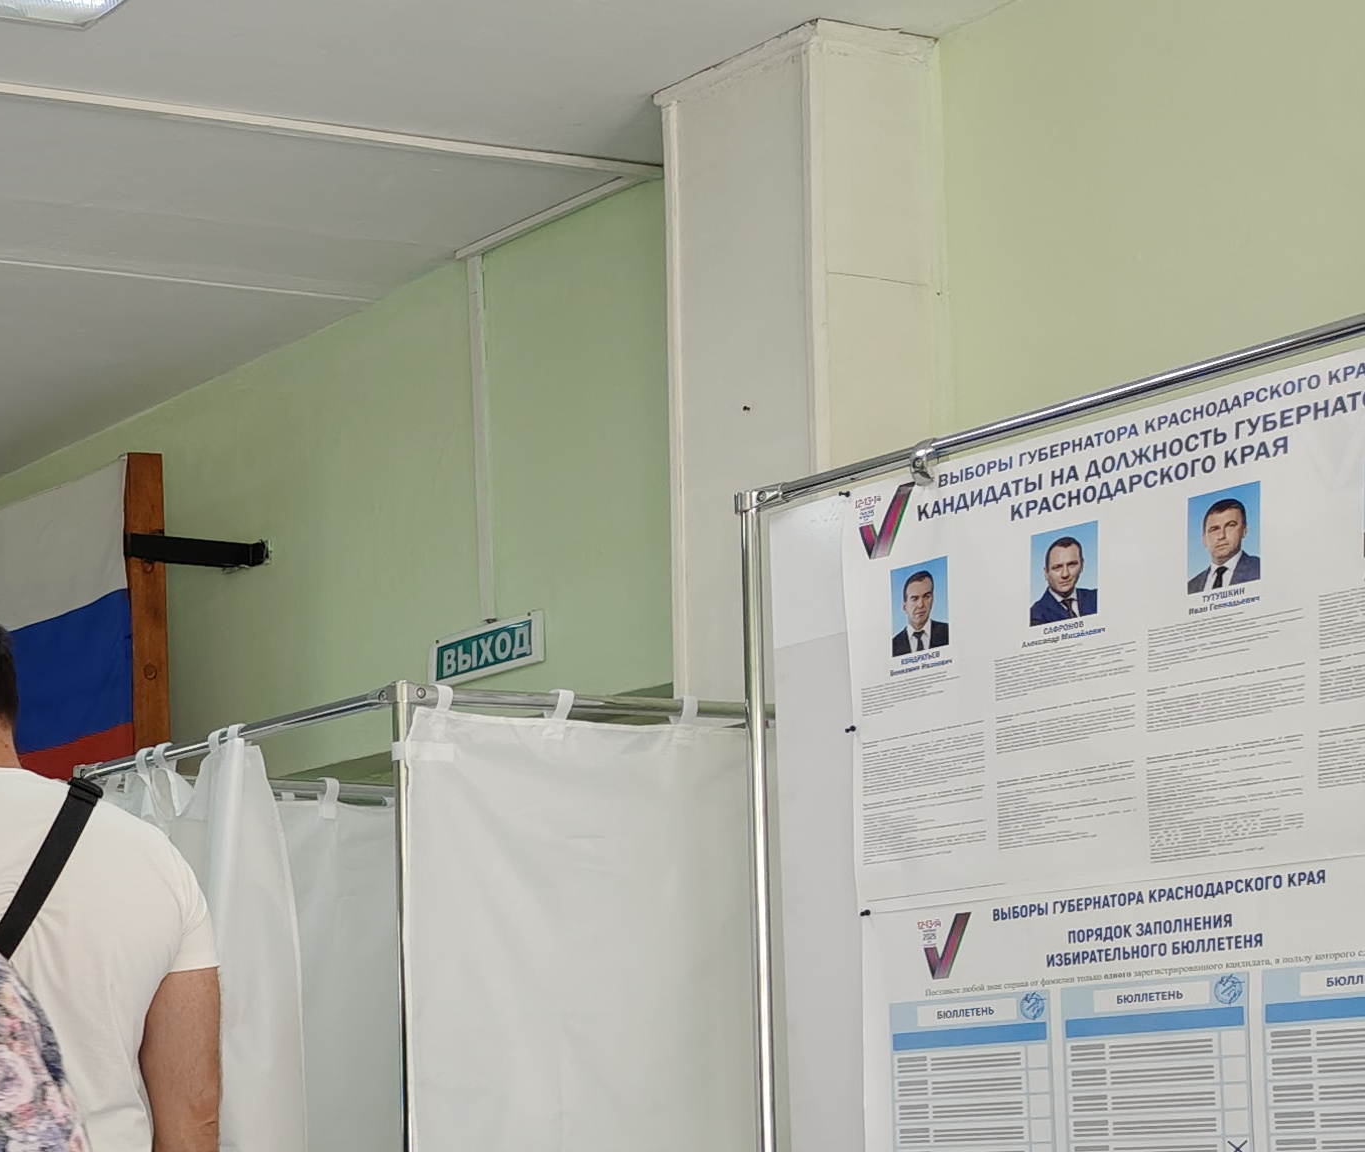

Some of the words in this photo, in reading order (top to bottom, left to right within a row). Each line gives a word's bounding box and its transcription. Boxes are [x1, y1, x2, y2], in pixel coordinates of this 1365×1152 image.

[938, 456, 1012, 488] ВЫБОРЫ
[1019, 423, 1139, 467] ГУБЕРНАТОРА
[1145, 374, 1320, 434] КРАСНОДАРСКОГО
[917, 474, 1043, 521] КАНДИДАТЫ
[1051, 465, 1079, 487] НА
[1085, 428, 1227, 483] ДОЛЖНОСТЬ
[1235, 391, 1365, 440] ГУБЕРНАТ
[1010, 455, 1216, 521] КРАСНОДАРСКОГО
[1224, 436, 1288, 468] КРАЯ
[442, 625, 531, 677] ВЫХОД
[992, 901, 1049, 921] ВЫБОРЫ
[1052, 891, 1145, 915] ГУБЕРНАТОРА
[1148, 875, 1283, 904] КРАСНОДАРСКОГО
[1287, 869, 1326, 888] КРАЯ
[1068, 924, 1133, 944] ПОРЯДОК
[1135, 913, 1233, 937] ЗАПОЛНЕНИЯ
[1046, 943, 1167, 968] ИЗБИРАТЕЛЬНОГО
[1171, 933, 1263, 954] БЮЛЛЕТЕНЯ
[1282, 954, 1313, 964] пользу
[1315, 951, 1356, 961] которого
[937, 1006, 995, 1020] БЮЛЛЕТЕНЬ
[1116, 989, 1184, 1005] БЮЛЛЕТЕНЬ
